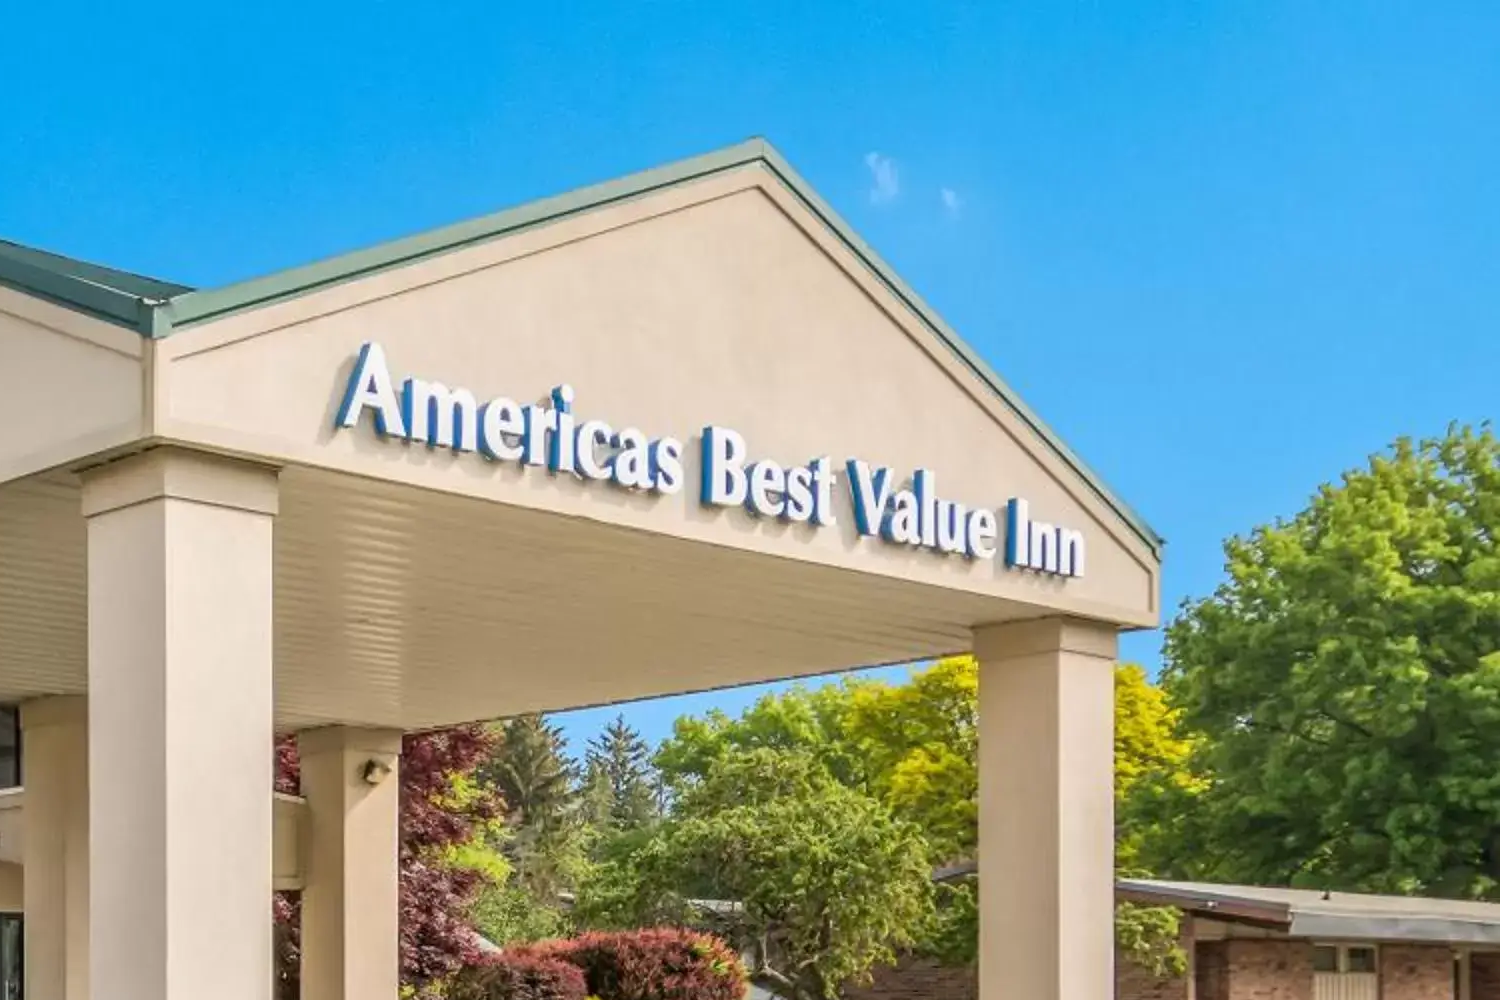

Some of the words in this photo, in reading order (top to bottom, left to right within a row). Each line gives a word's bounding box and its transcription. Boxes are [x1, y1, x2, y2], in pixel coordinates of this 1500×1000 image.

[337, 341, 683, 496] Americas
[701, 425, 836, 526] Best
[846, 457, 998, 560] Value
[1006, 497, 1085, 578] Inn
